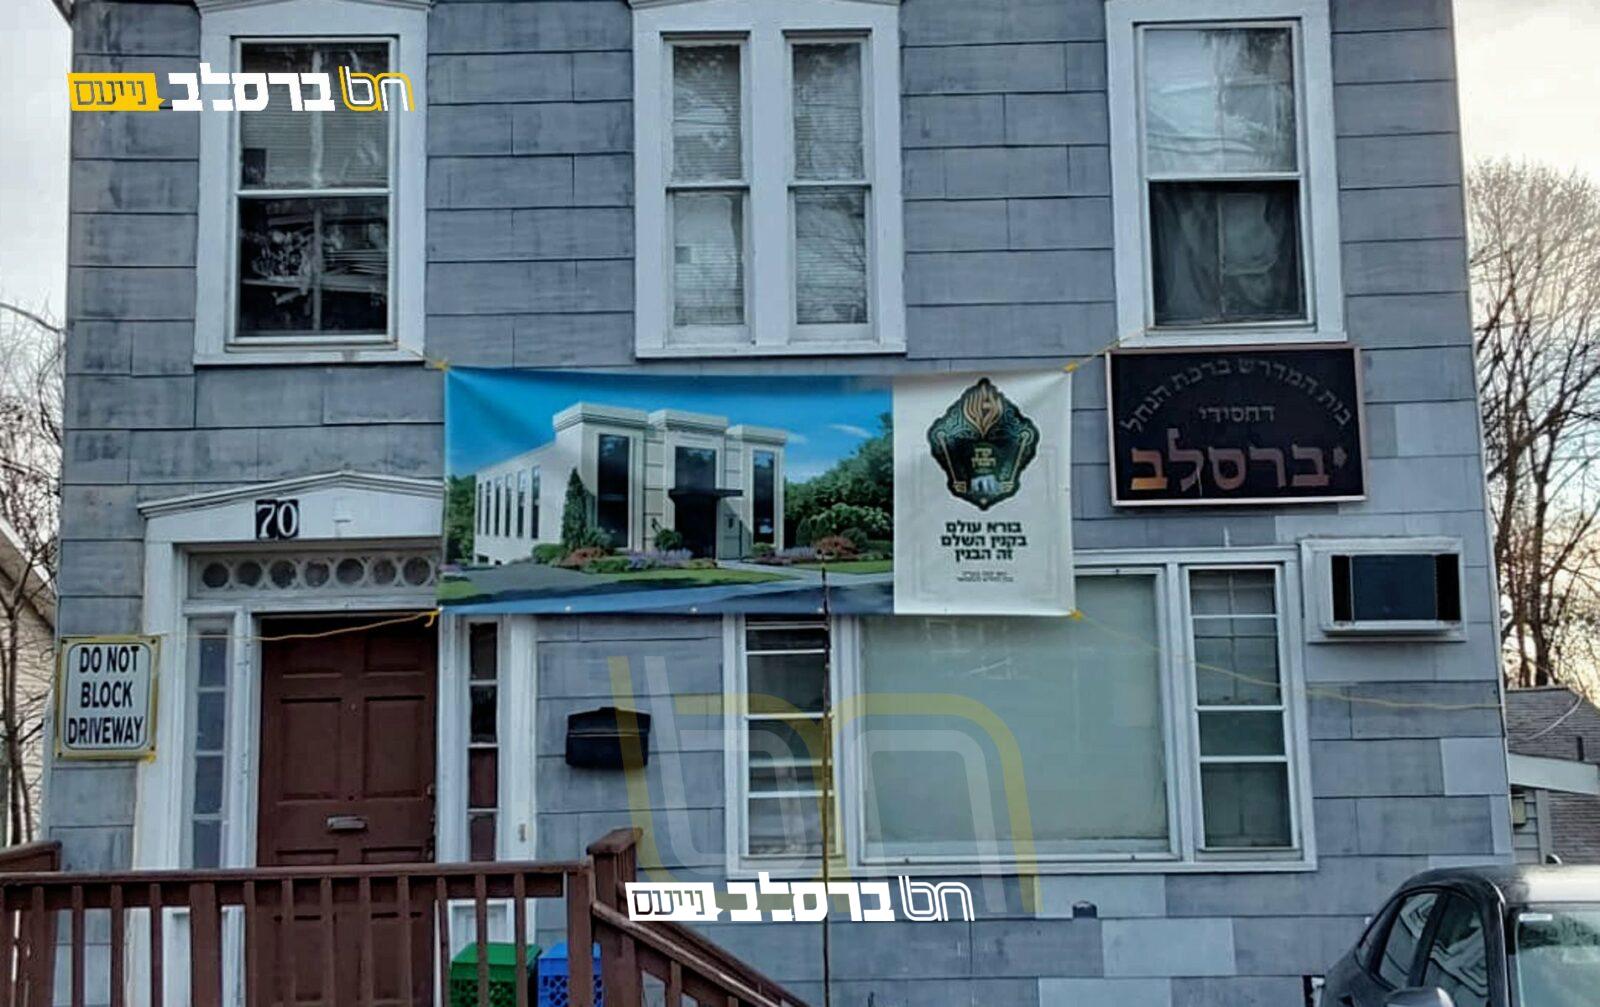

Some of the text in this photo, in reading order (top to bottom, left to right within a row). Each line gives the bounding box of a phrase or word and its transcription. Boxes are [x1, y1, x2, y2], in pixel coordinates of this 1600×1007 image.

[1171, 357, 1233, 392] ברכת
[1238, 358, 1321, 395] המדרש
[1119, 384, 1172, 433] הנחל
[256, 502, 299, 538] 70
[945, 520, 1022, 533] בורא עולם
[941, 533, 1028, 549] בקנין השלם
[955, 548, 1014, 563] זה הבנין
[79, 646, 140, 673] DO NOT
[80, 681, 134, 709] BLOCK
[68, 716, 144, 744] DRIVEWAY
